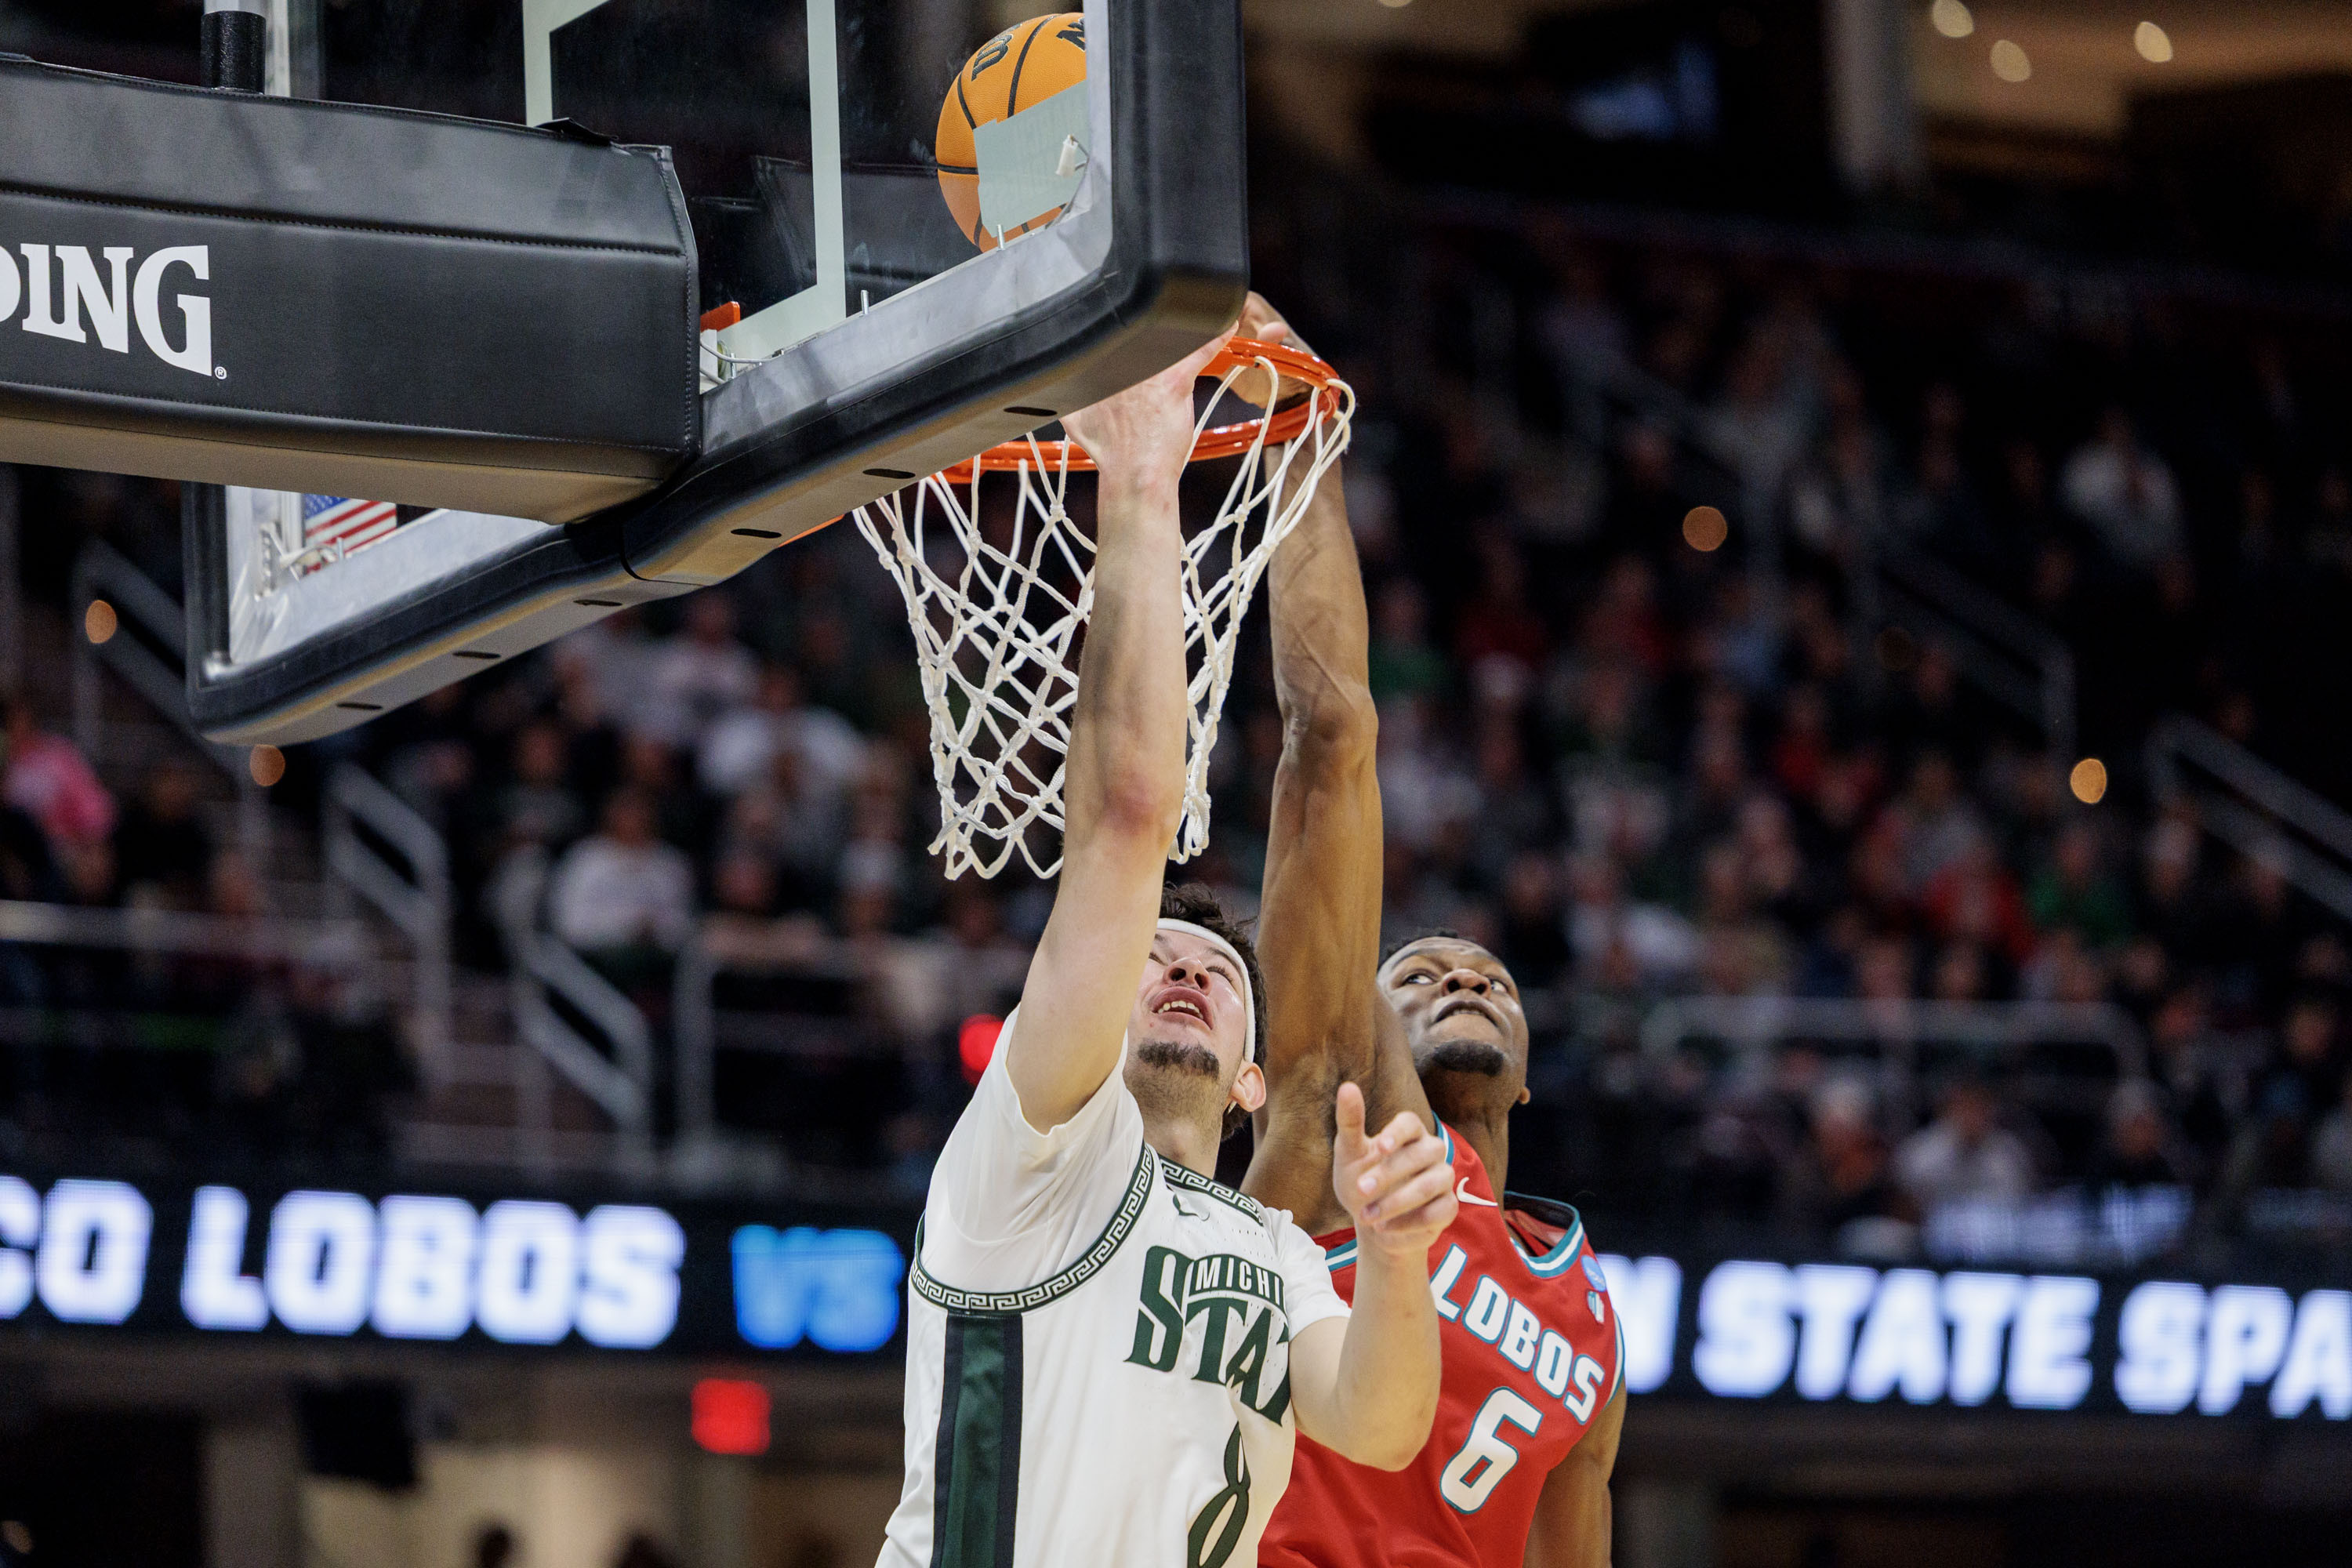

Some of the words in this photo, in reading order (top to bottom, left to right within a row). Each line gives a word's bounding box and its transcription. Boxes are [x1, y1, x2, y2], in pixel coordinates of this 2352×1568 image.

[180, 1185, 687, 1350] LOBOS
[730, 1224, 906, 1352] VS
[1691, 1260, 2100, 1411] STATE
[2114, 1281, 2352, 1420] SPA
[1430, 1243, 1605, 1425] LOBOS
[1187, 1421, 1250, 1568] 8
[1440, 1386, 1544, 1514] 6
